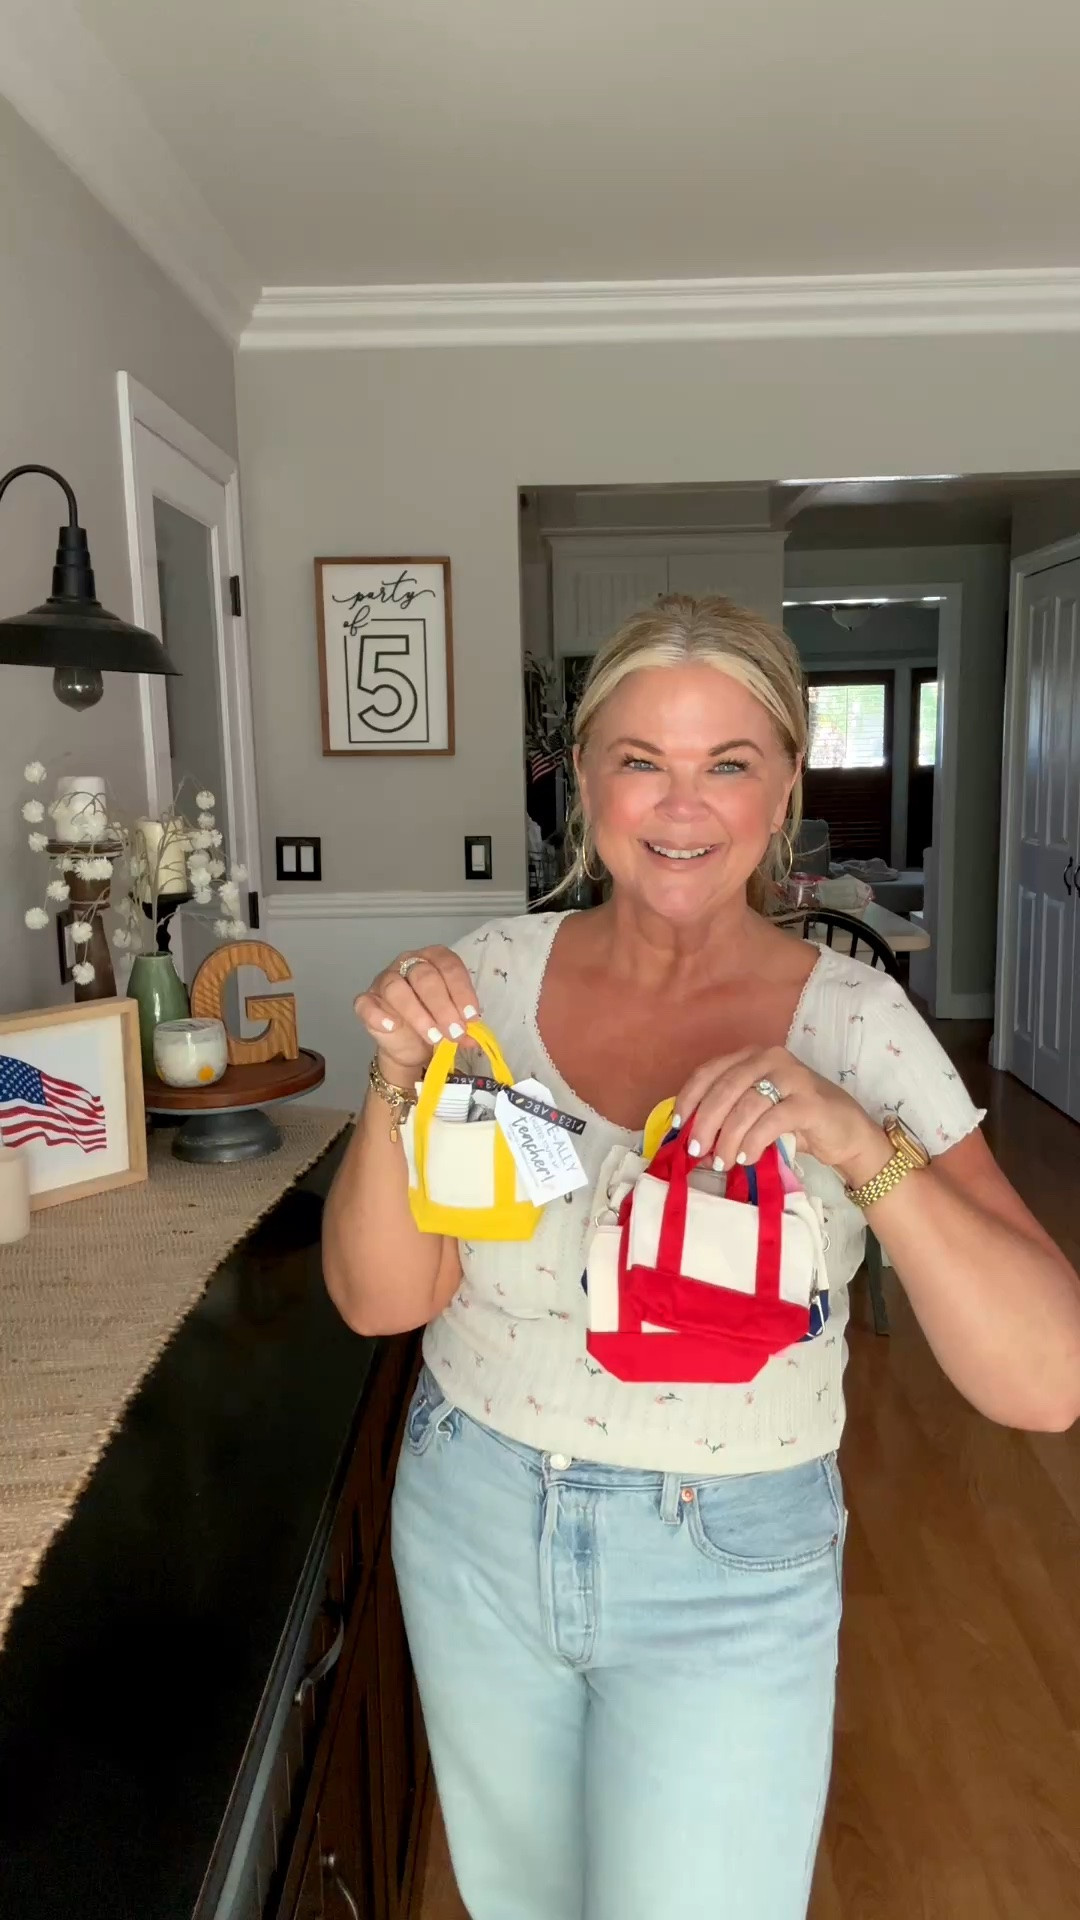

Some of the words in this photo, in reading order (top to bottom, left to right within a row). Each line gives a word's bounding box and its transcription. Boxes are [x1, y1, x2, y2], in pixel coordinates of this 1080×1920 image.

[332, 570, 436, 609] party
[343, 605, 371, 636] of
[357, 635, 418, 733] 5
[190, 939, 299, 1065] G
[524, 1101, 549, 1115] ABC
[560, 1115, 577, 1128] 123
[511, 1116, 555, 1182] teacher!
